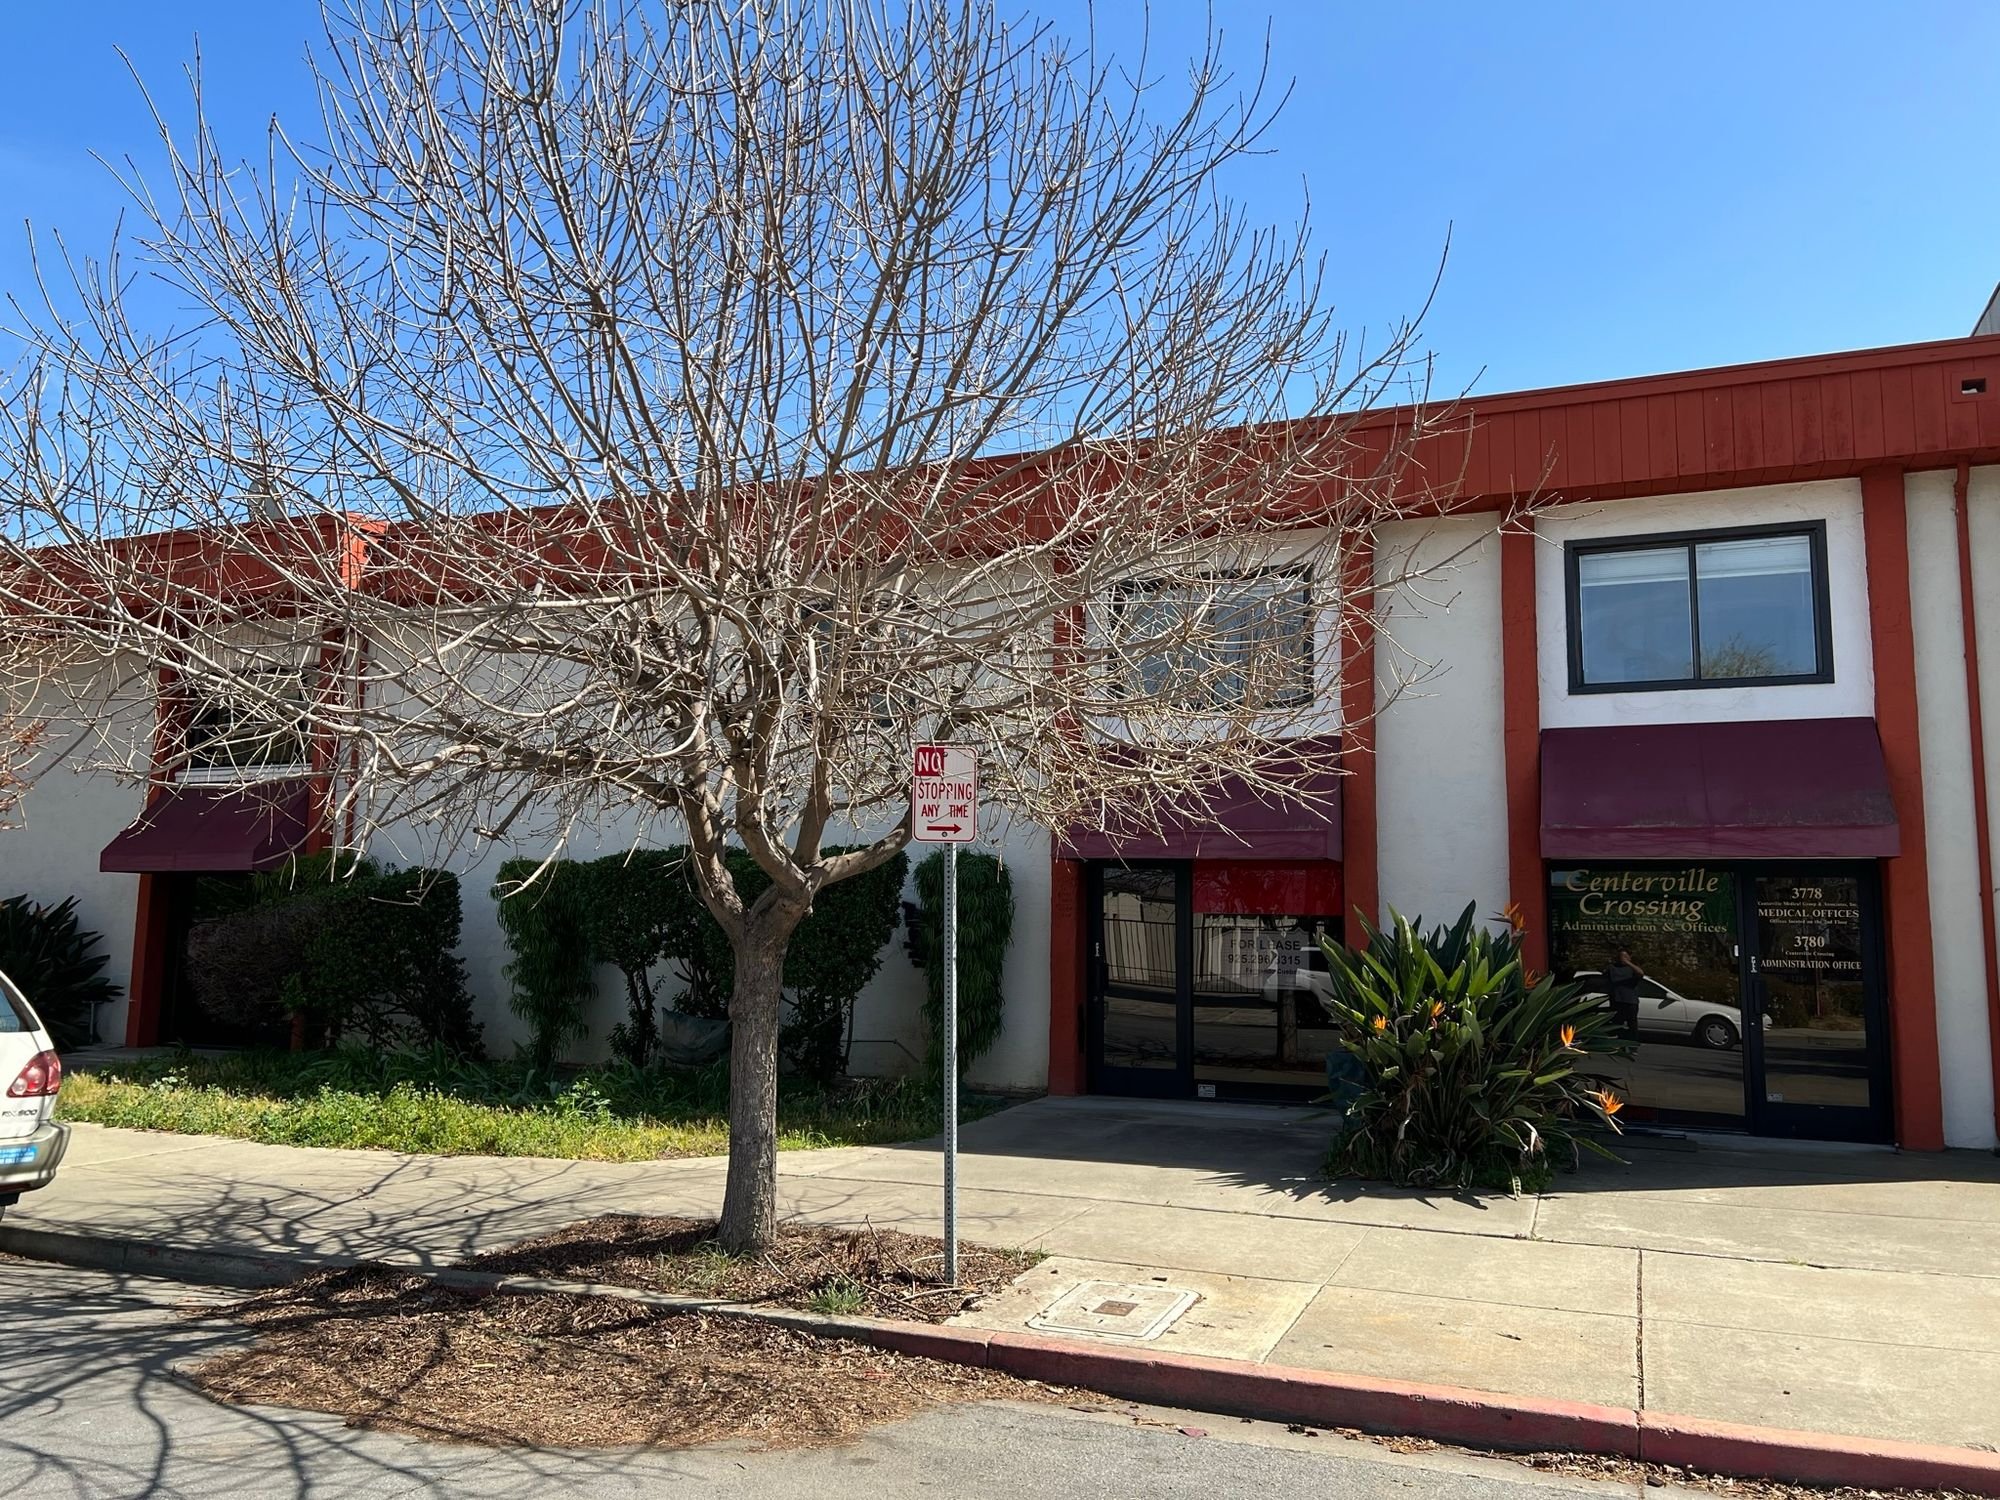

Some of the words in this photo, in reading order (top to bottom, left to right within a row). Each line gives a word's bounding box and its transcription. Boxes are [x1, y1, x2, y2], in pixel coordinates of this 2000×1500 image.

[917, 751, 942, 772] NO
[918, 783, 972, 800] STOPPING
[921, 804, 940, 817] ANY
[949, 804, 968, 818] TIME
[1566, 868, 1719, 892] Centerville
[1791, 887, 1822, 899] 3778
[1579, 892, 1705, 921] Crossing
[1758, 908, 1809, 917] MEDICAL
[1812, 909, 1860, 918] OFFICES
[1562, 921, 1656, 932] Administration
[1663, 922, 1675, 932] &
[1681, 922, 1727, 933] Offices
[1230, 940, 1255, 948] FOR
[1794, 936, 1825, 948] 3780
[1760, 959, 1830, 969] ADMINISTRATION
[1832, 961, 1862, 970] OFFICE
